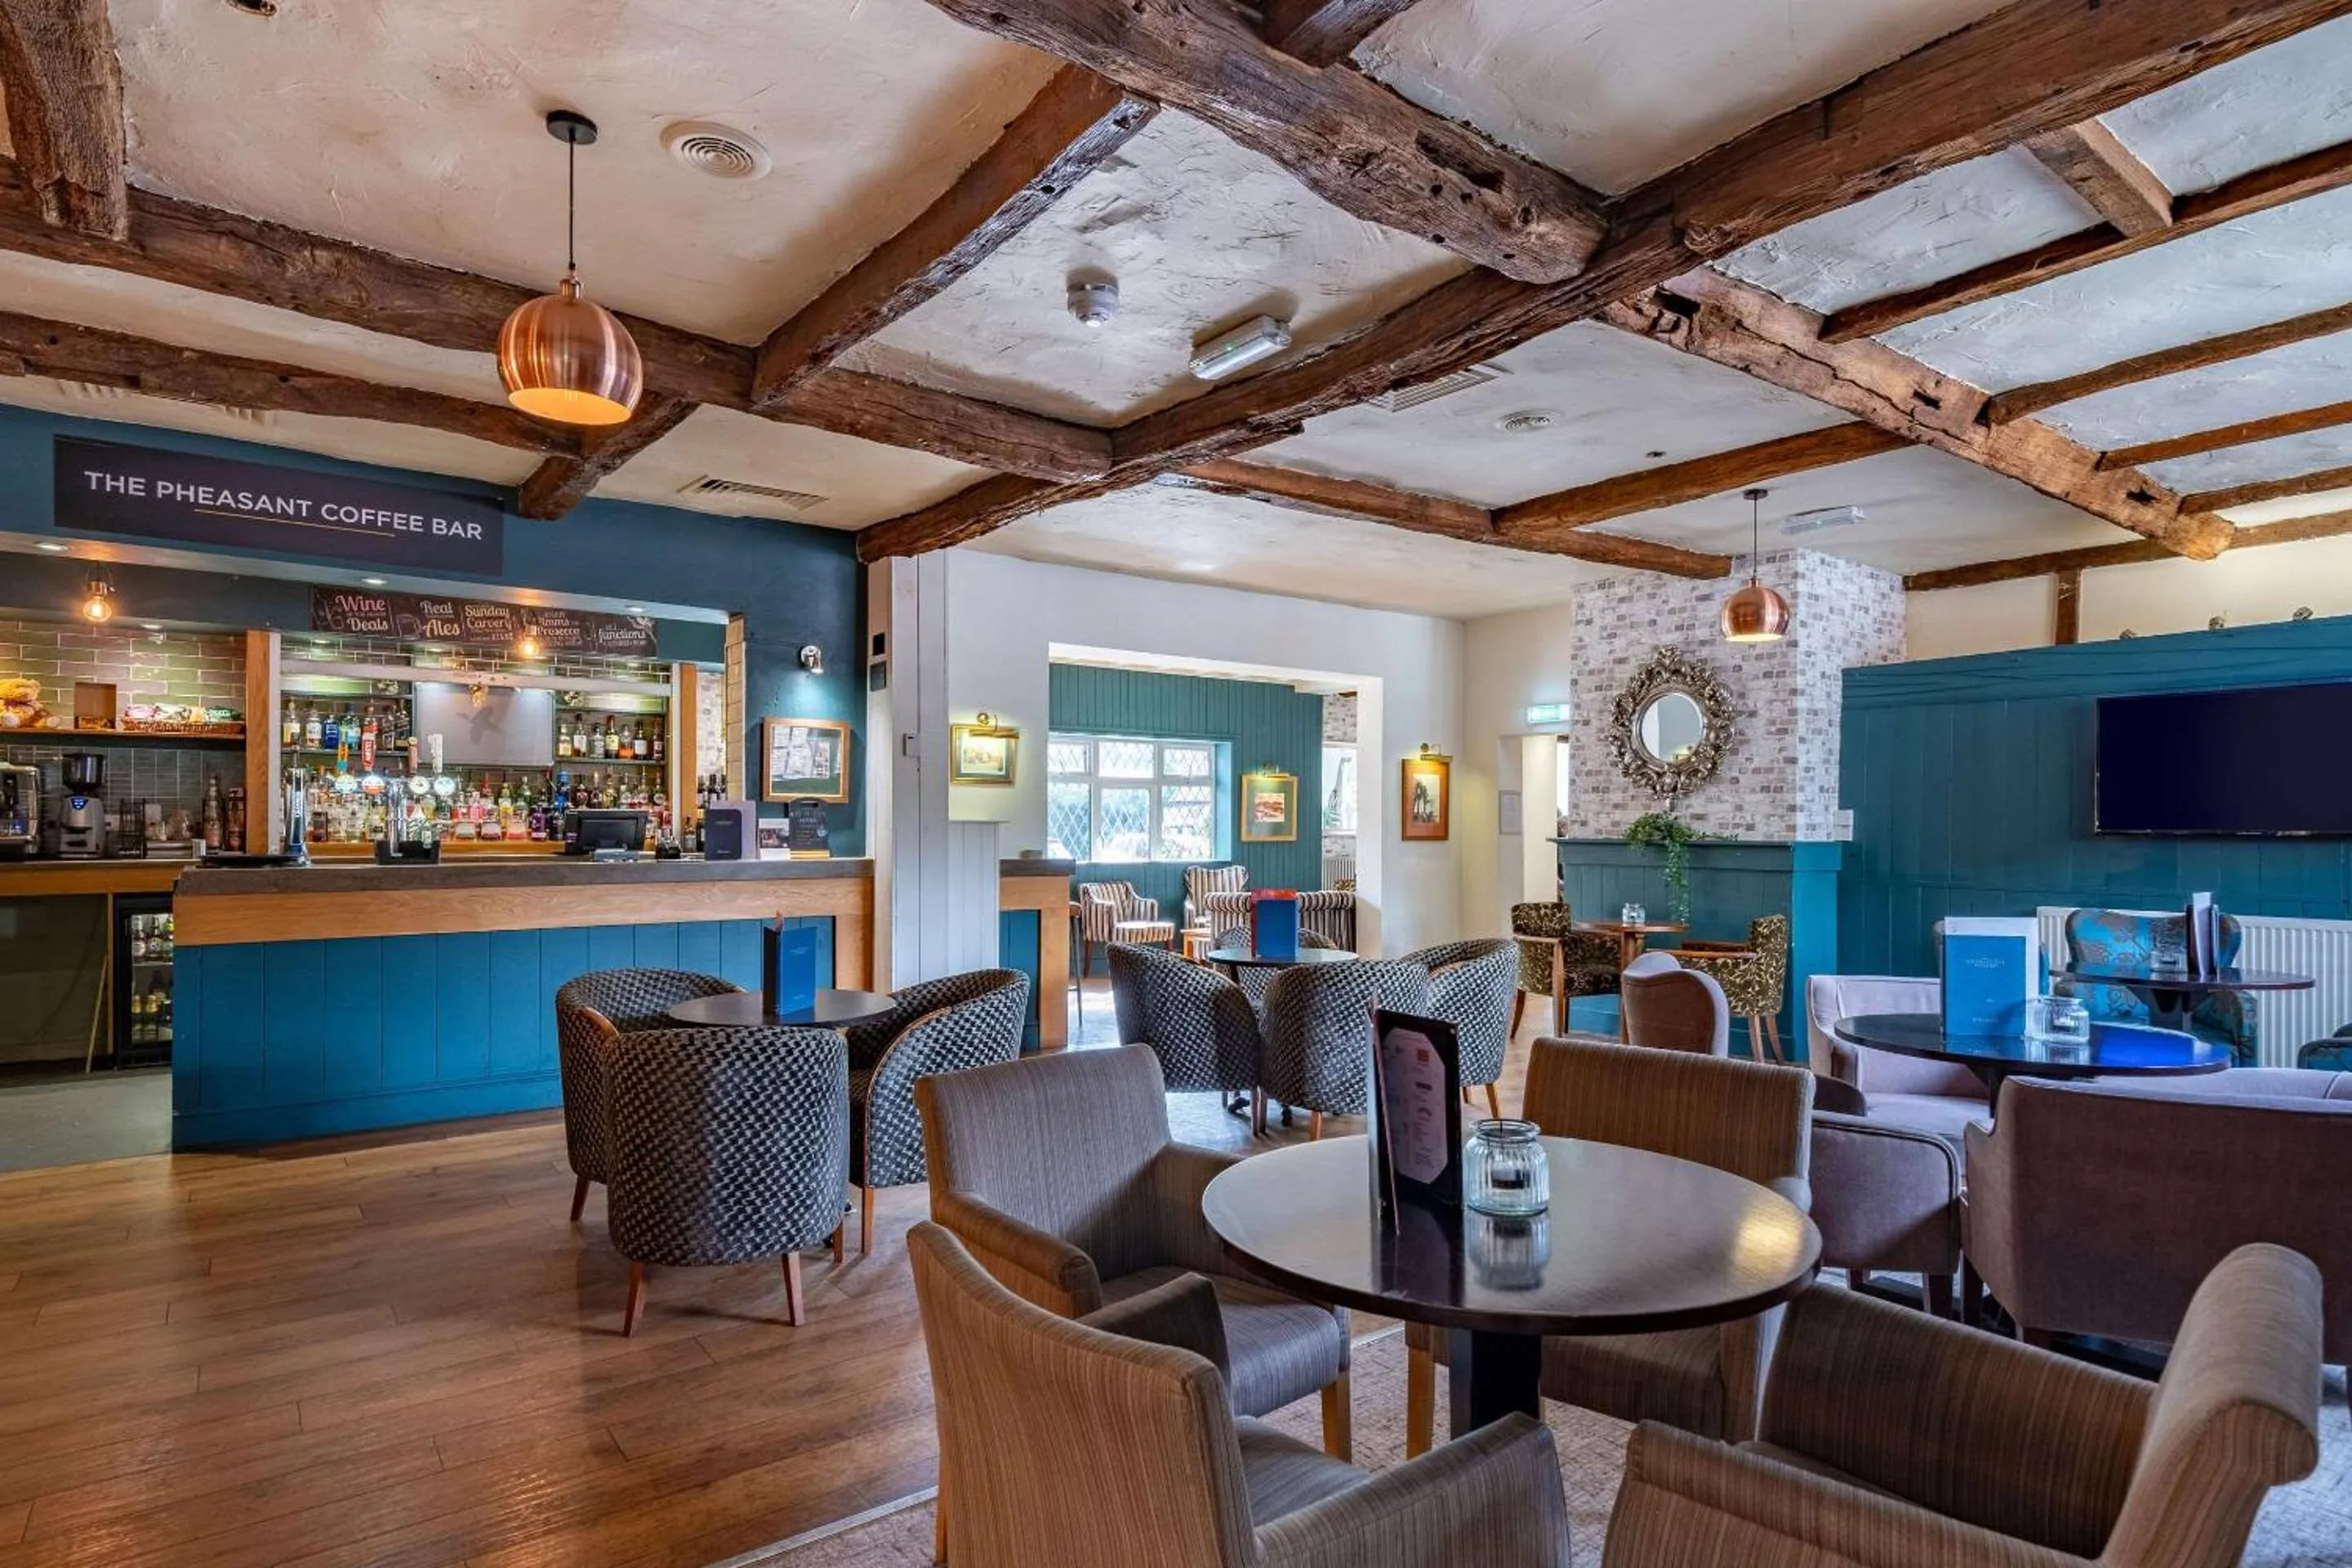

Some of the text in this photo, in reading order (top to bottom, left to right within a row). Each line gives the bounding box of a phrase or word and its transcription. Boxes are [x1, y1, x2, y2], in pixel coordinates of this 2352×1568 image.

[84, 470, 483, 541] THE PHEASANT COFFEE BAR
[335, 595, 386, 612] Wine
[420, 600, 455, 614] Real
[465, 604, 510, 618] Sunday
[346, 617, 389, 631] Deals
[423, 619, 461, 637] Ales
[466, 617, 512, 630] Carvery
[537, 626, 581, 636] Prosecco
